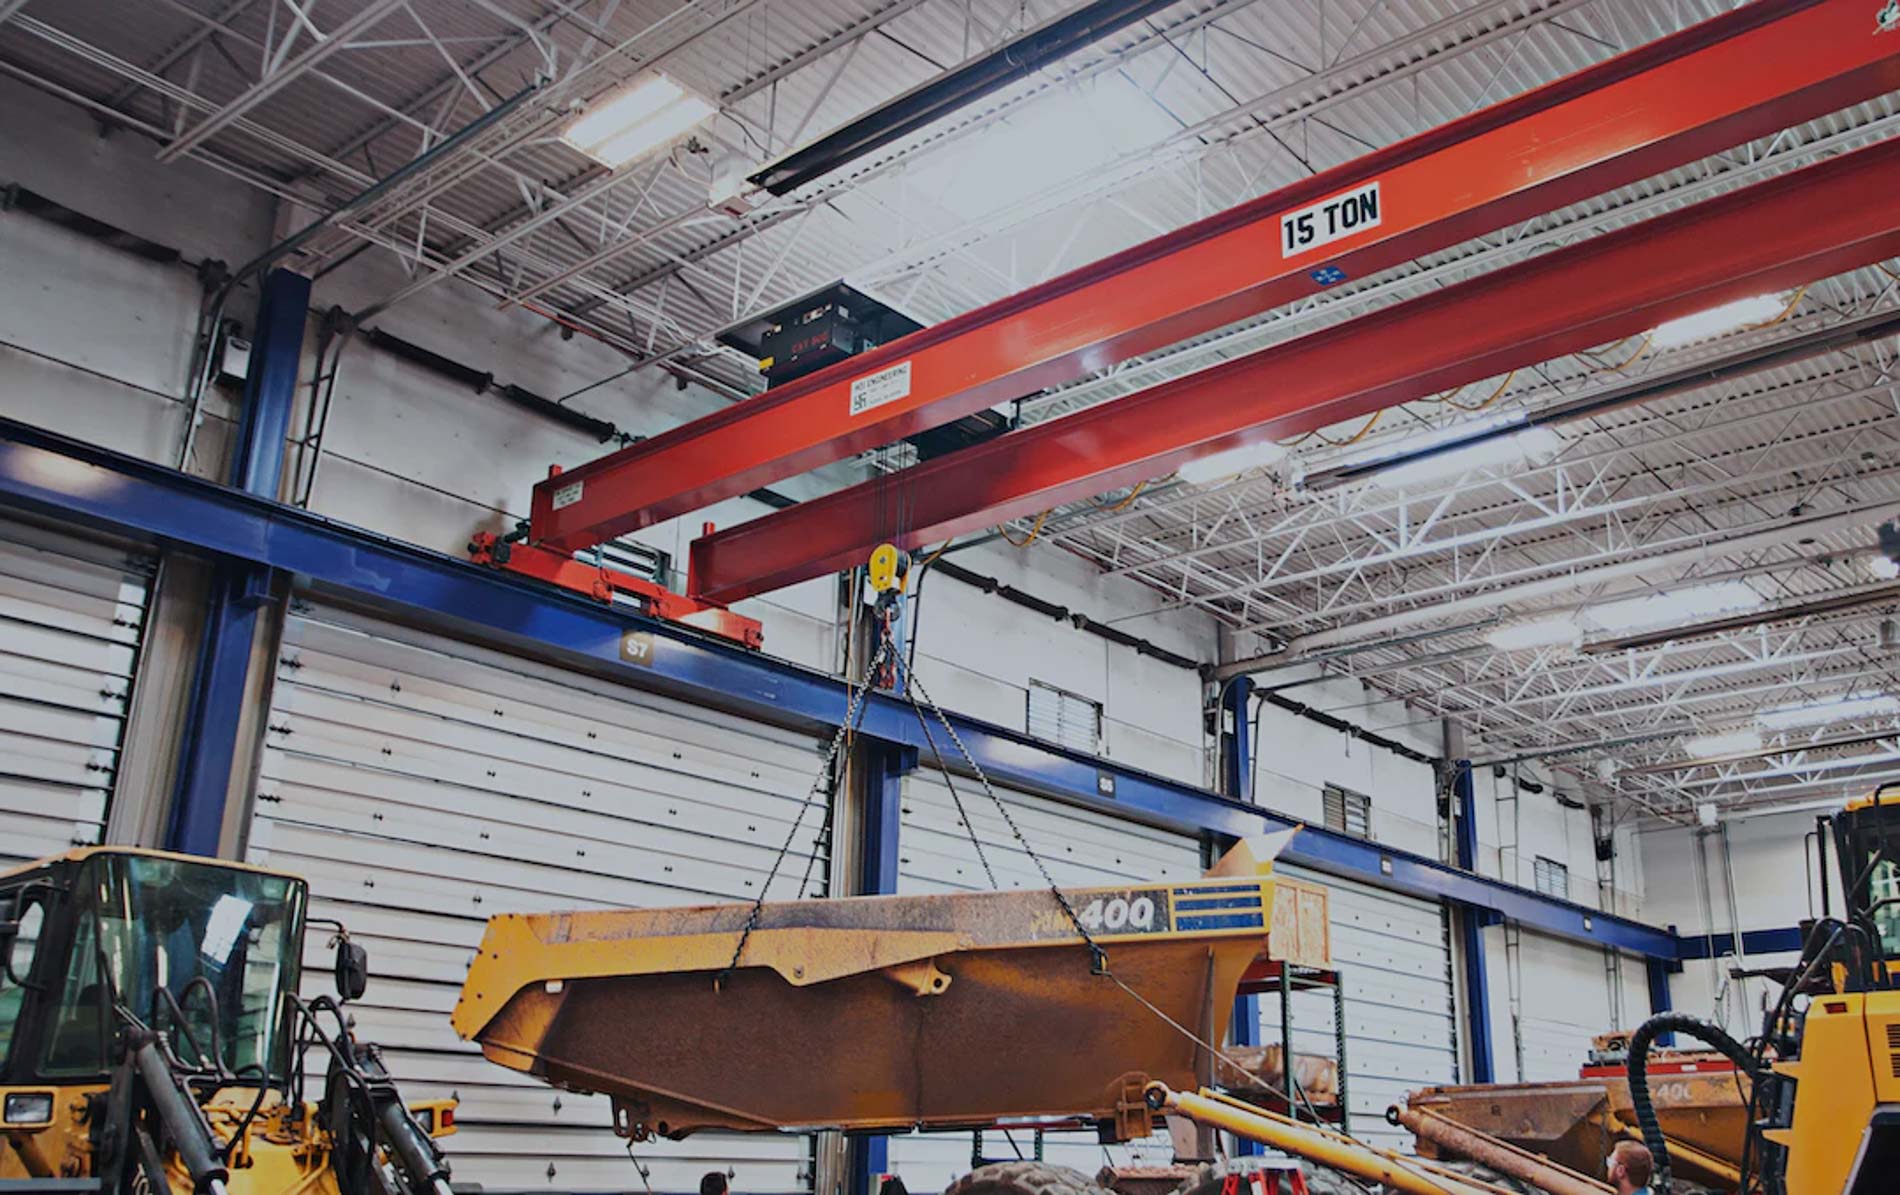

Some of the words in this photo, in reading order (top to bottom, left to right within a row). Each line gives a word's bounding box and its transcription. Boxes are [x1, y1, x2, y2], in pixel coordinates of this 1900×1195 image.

[1284, 212, 1315, 250] 15
[1323, 189, 1378, 235] TON
[626, 639, 649, 659] S7
[1080, 897, 1156, 930] 400
